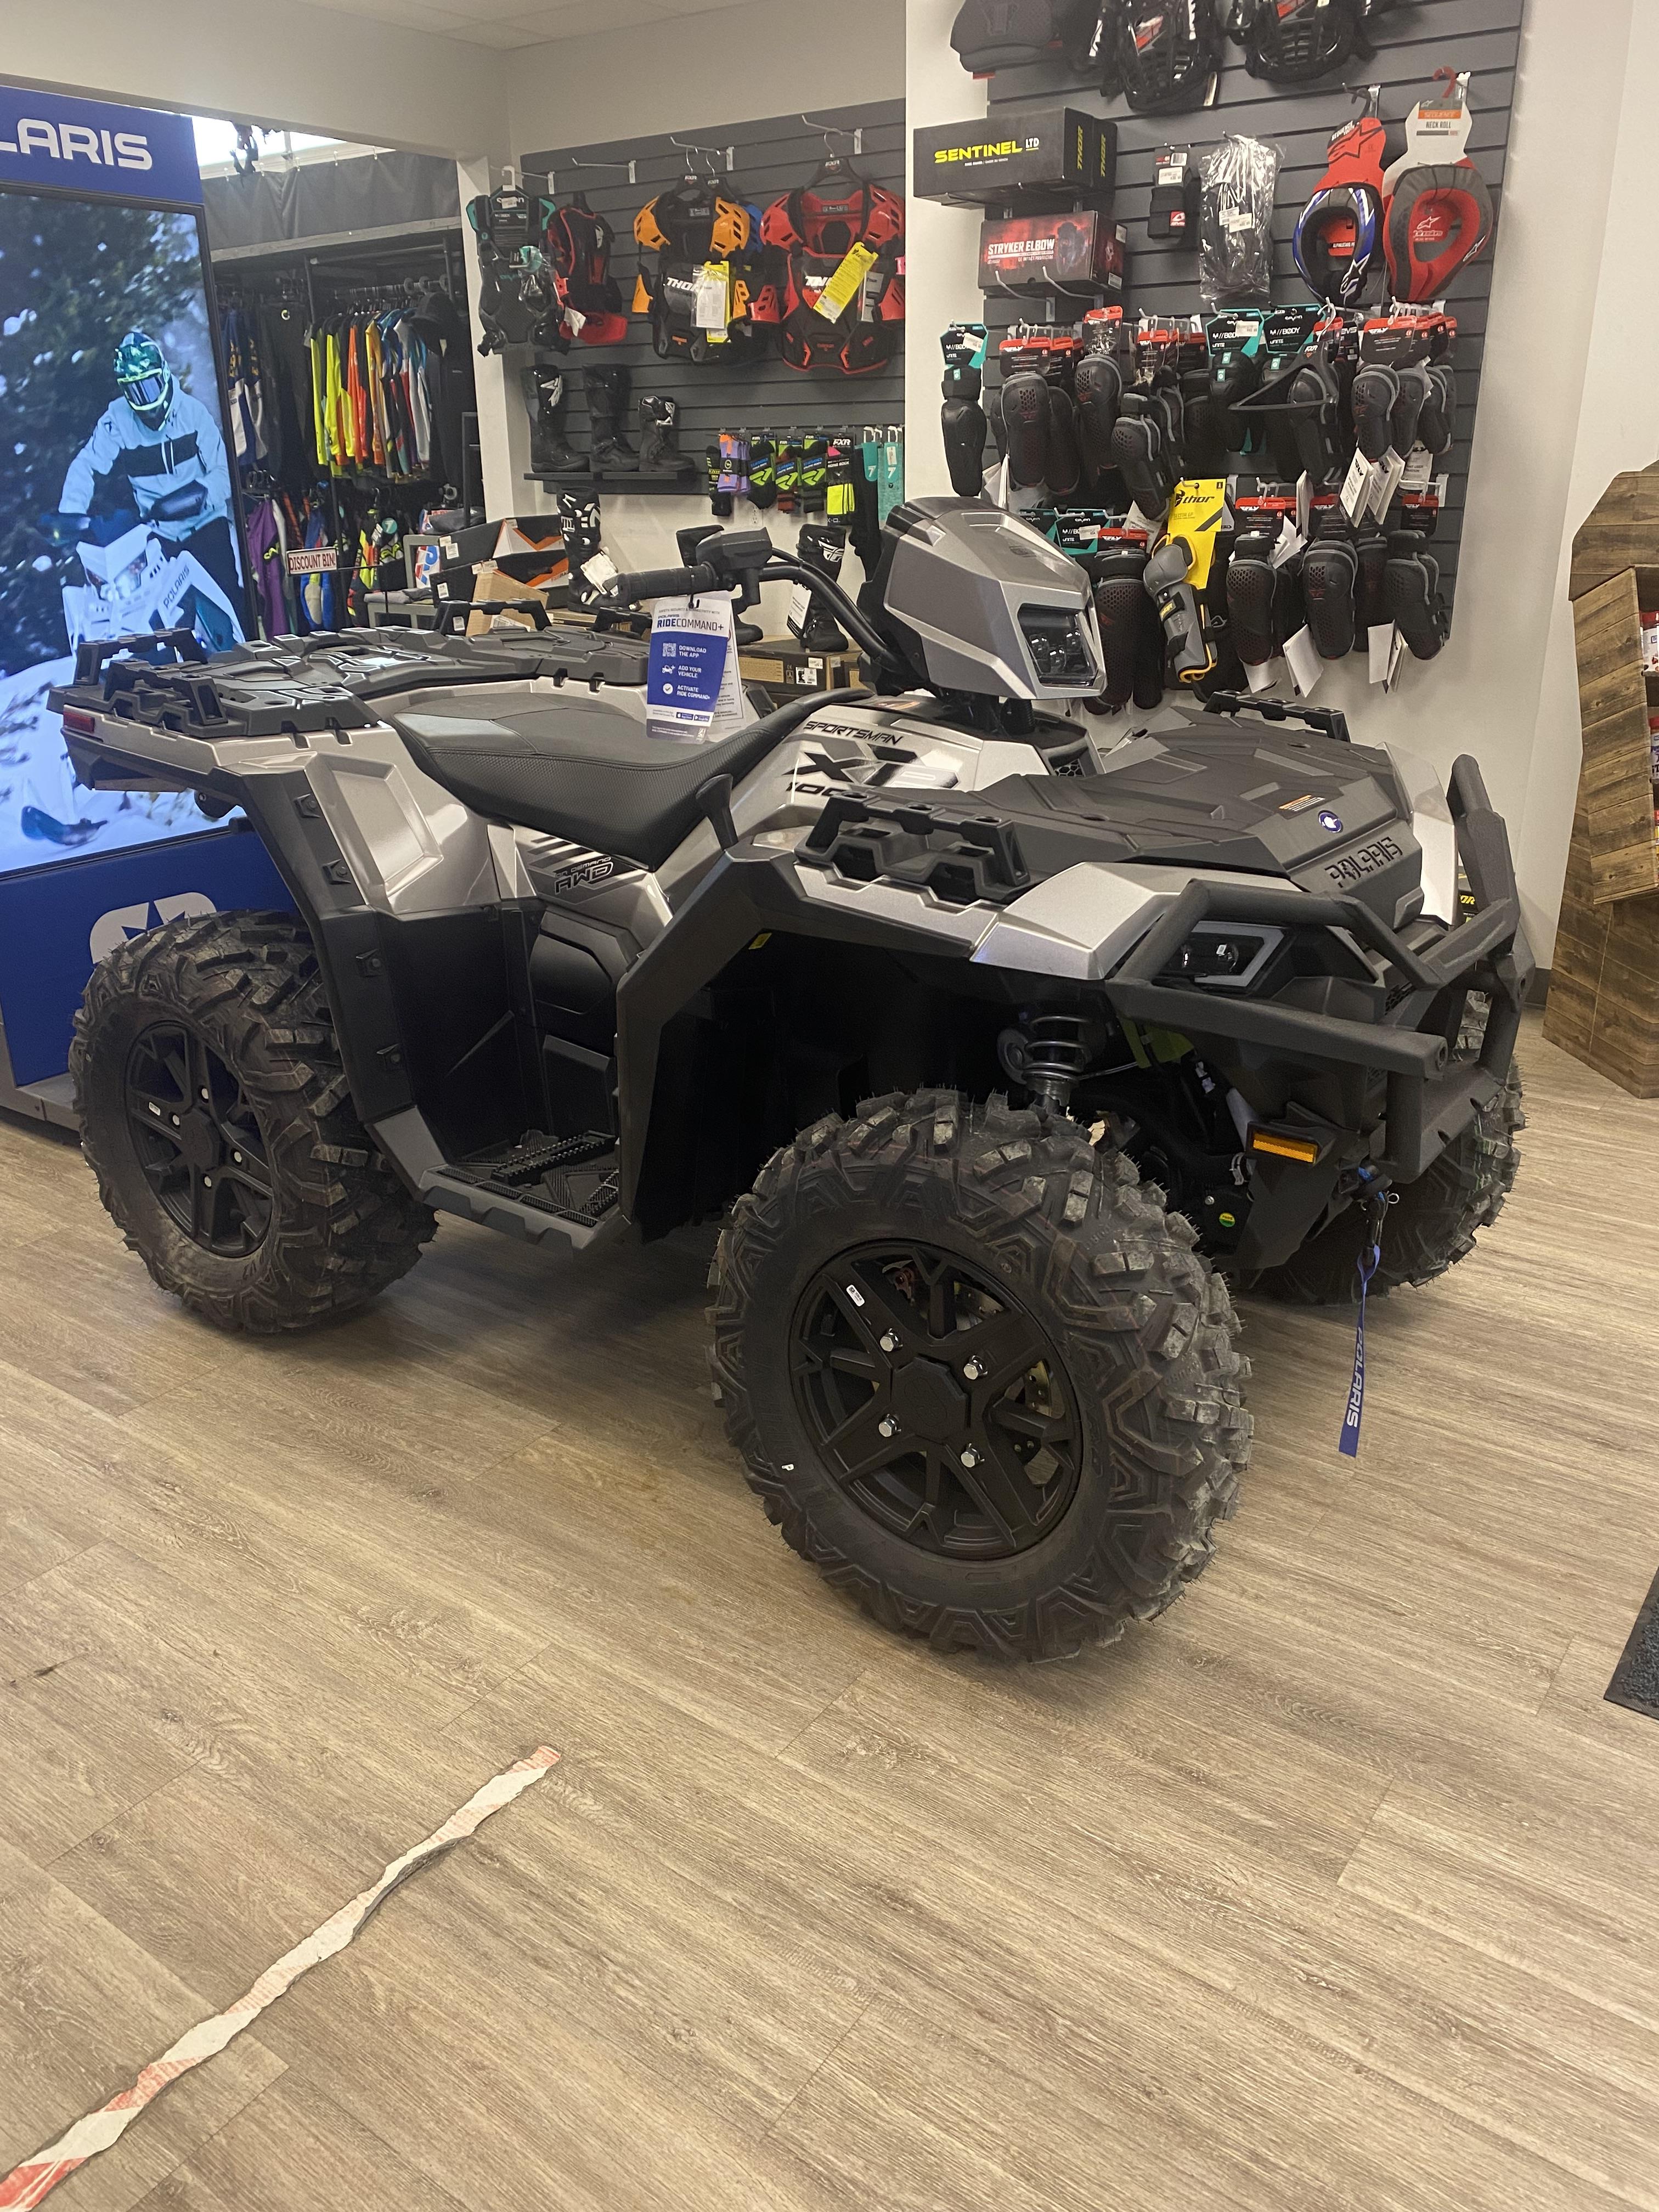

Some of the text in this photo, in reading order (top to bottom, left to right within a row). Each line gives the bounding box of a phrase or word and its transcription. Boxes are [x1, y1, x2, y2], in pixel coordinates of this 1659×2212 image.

[934, 141, 1023, 163] SENTINEL
[1025, 137, 1040, 148] LTD
[988, 239, 1055, 255] STRYKER ELBOW
[1183, 495, 1215, 504] thor
[289, 552, 336, 571] DISCOUNT BIN!
[163, 565, 189, 610] POLARIS
[679, 645, 707, 653] DOWNLOAD
[803, 720, 904, 746] SPORTSMAN
[1324, 837, 1403, 888] POLARIS
[554, 861, 614, 895] AWD
[1347, 1327, 1363, 1429] POLARIS
